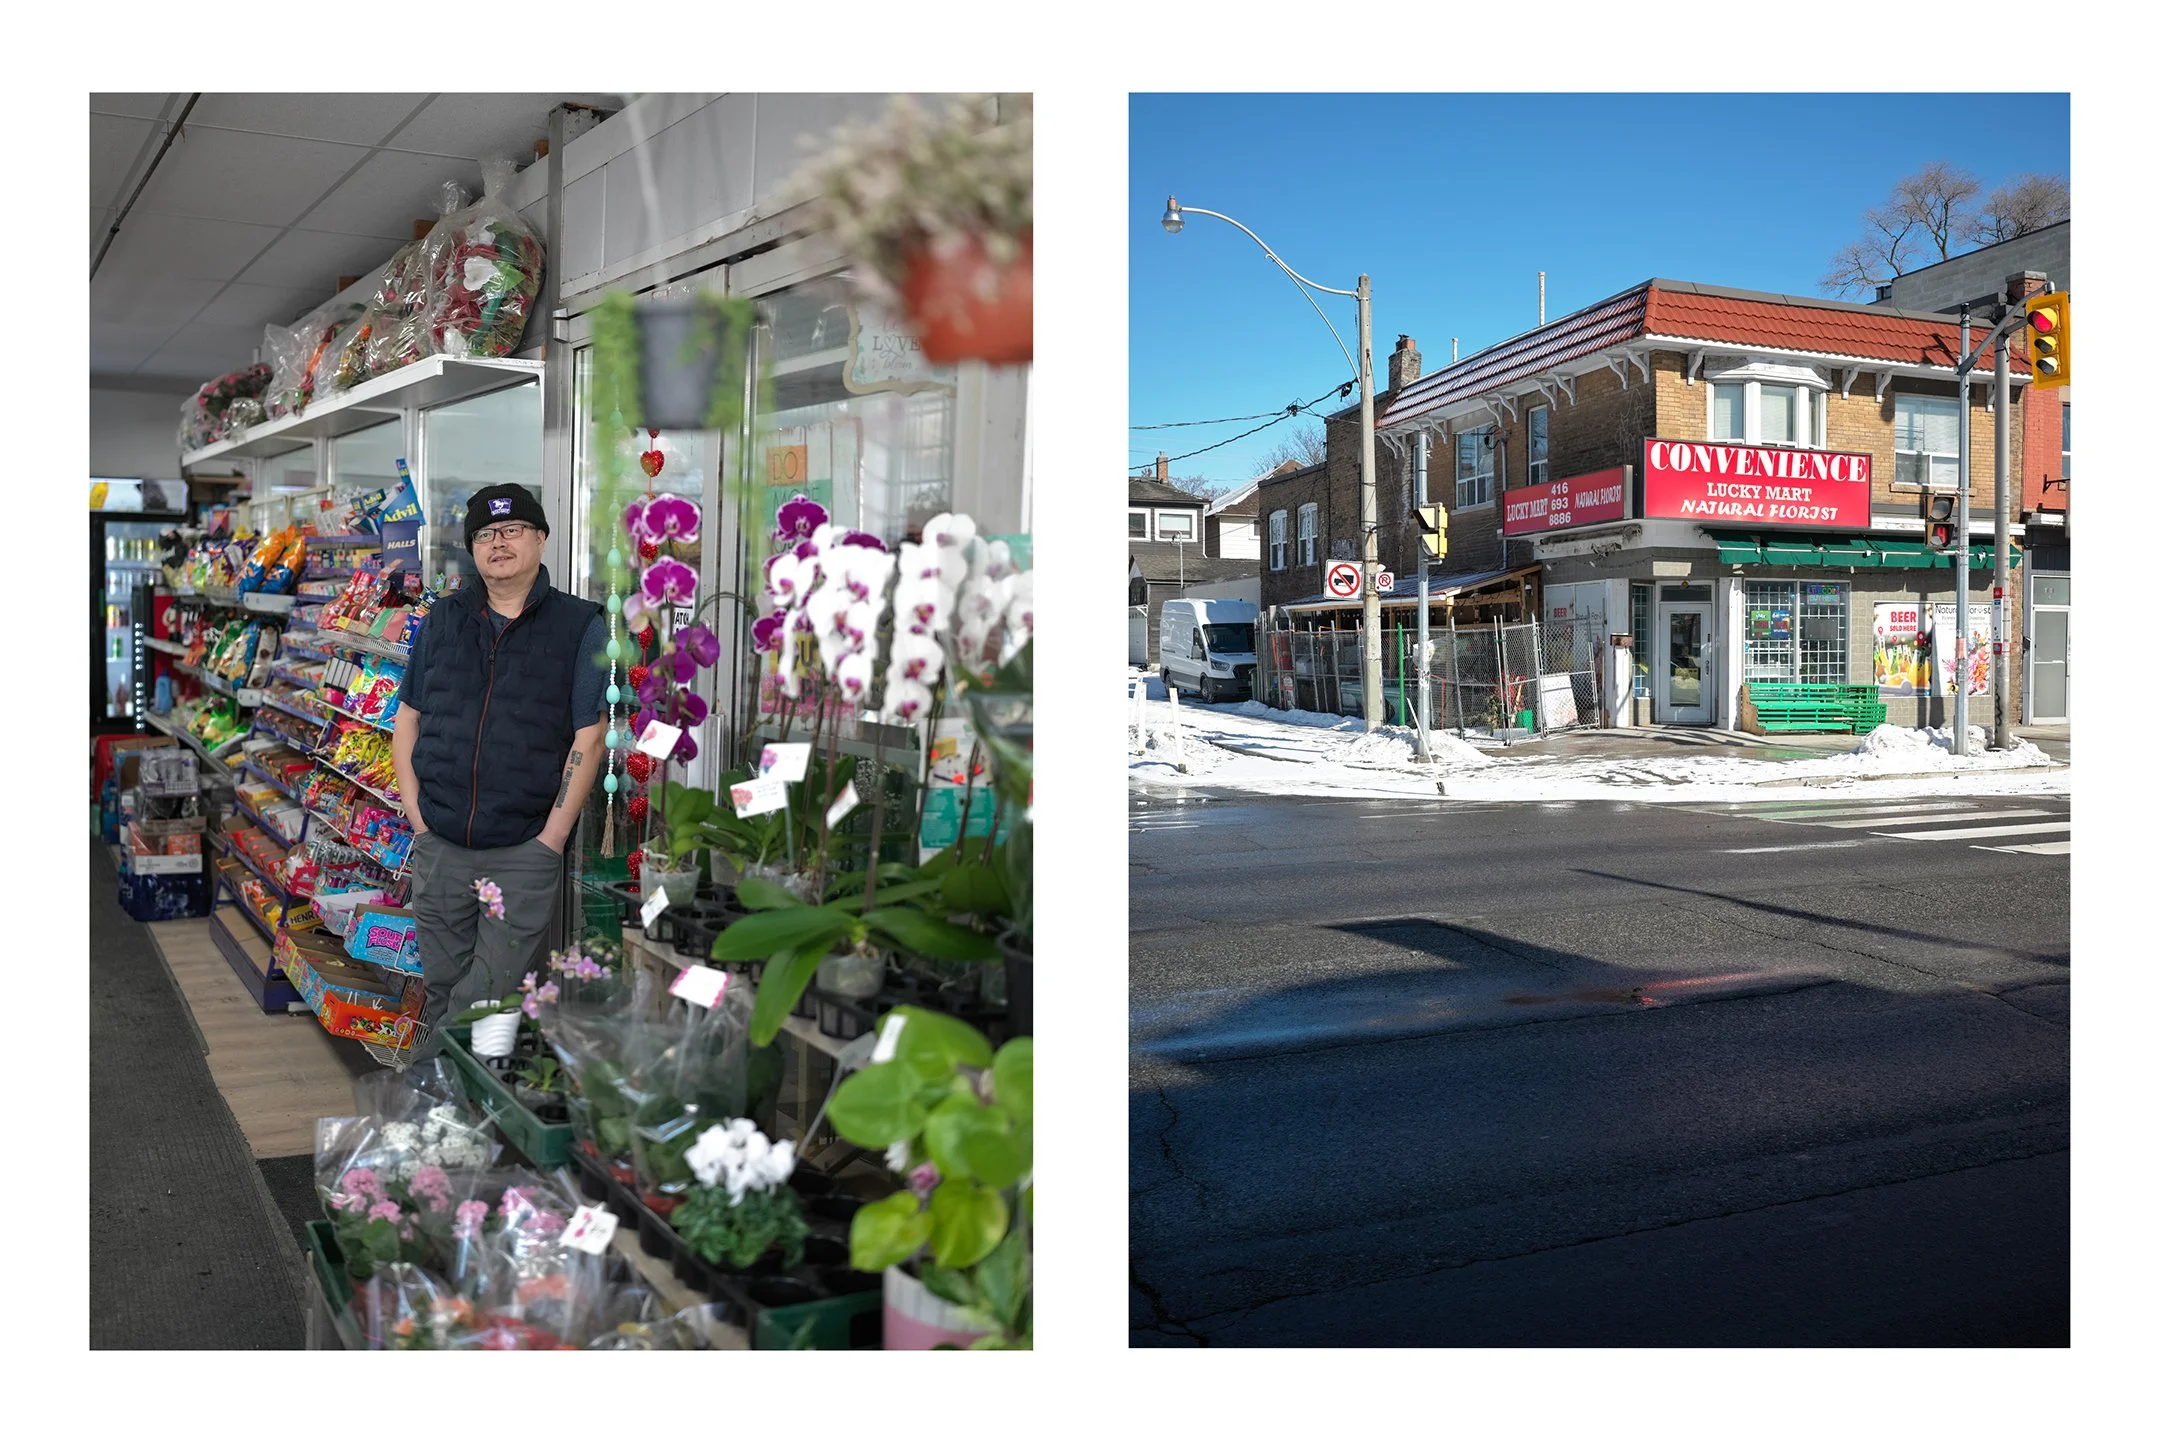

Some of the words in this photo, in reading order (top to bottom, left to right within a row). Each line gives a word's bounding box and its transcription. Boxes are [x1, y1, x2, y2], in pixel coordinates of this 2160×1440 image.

[1650, 441, 1866, 482] CONVENIENCE
[1551, 482, 1568, 495] 416
[1707, 482, 1762, 499] LUCKY
[1766, 486, 1812, 501] MART
[1507, 500, 1528, 522] LUCKY
[1530, 498, 1548, 518] MART
[1551, 497, 1568, 510] 693
[1680, 499, 1764, 517] NATURAL
[1769, 503, 1838, 520] FLORIST
[384, 503, 417, 522] Advil
[1549, 512, 1571, 525] 8886
[387, 539, 416, 550] HALLS
[1890, 611, 1917, 623] BEER
[290, 910, 319, 924] HENR
